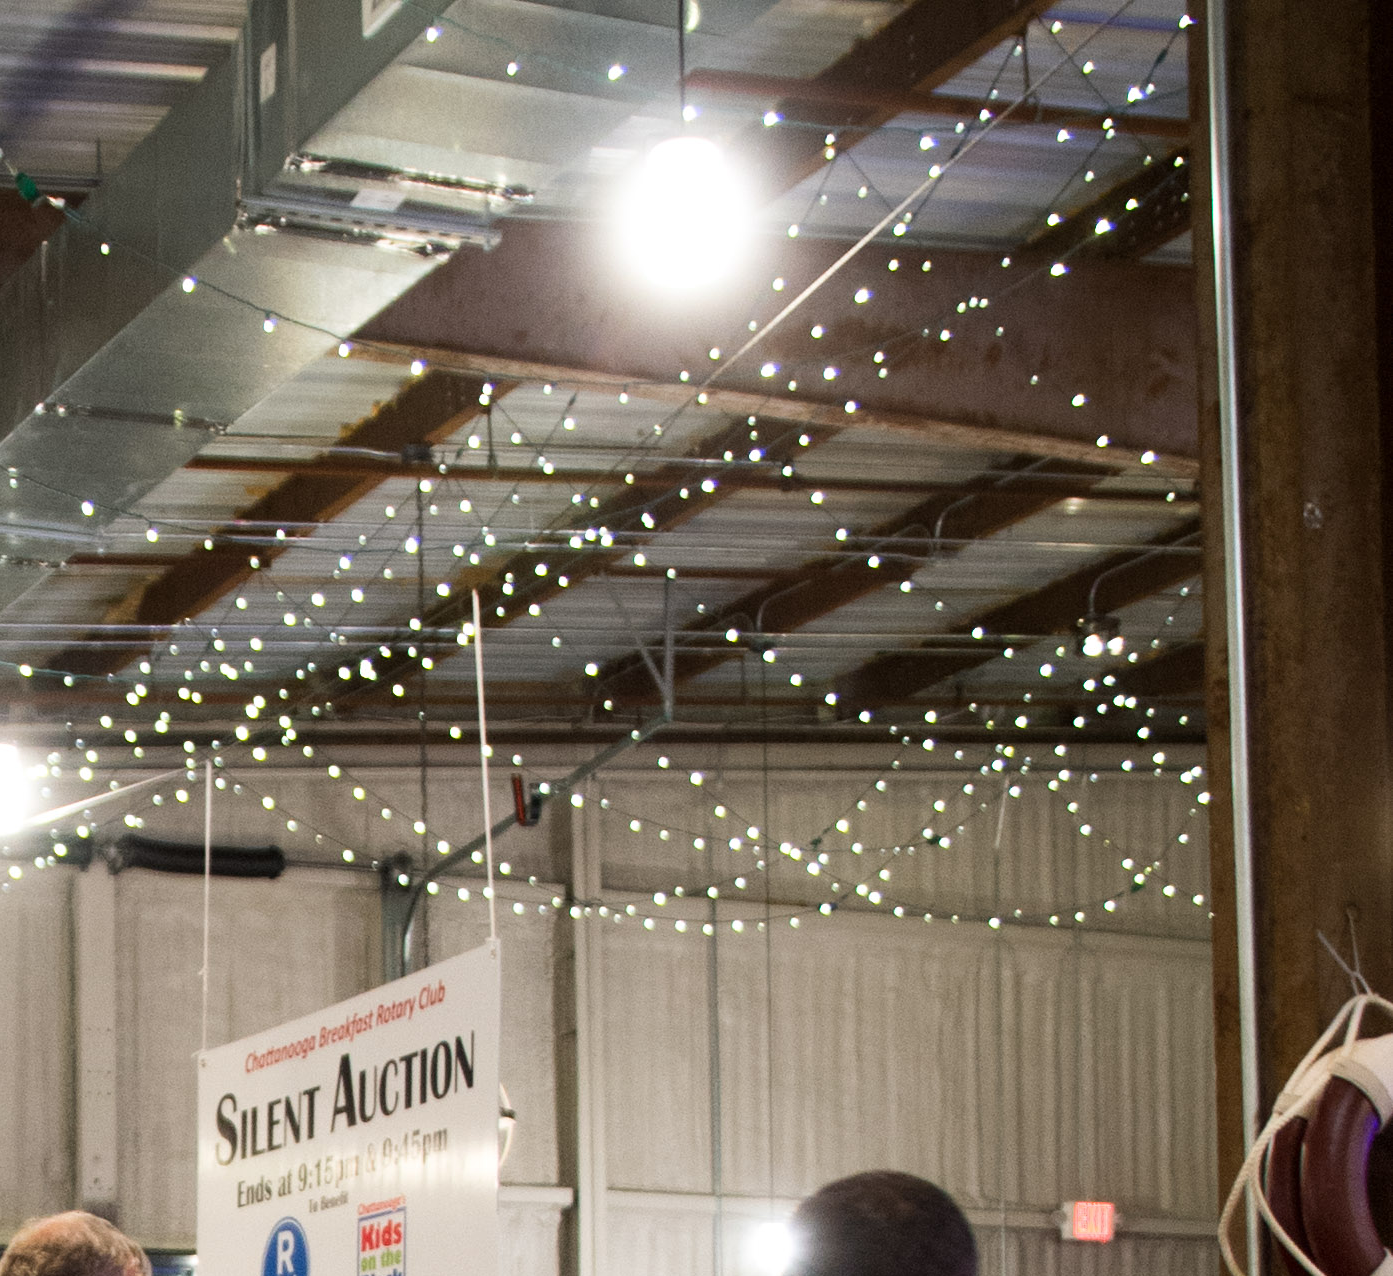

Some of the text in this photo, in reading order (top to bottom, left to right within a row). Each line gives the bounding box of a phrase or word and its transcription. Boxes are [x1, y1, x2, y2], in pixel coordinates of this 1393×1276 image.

[245, 979, 446, 1074] Chattanooga Breakfast Rotary Club
[215, 1029, 475, 1167] SILENT AUCTION
[237, 1173, 273, 1208] Ends
[278, 1170, 292, 1198] at
[276, 1230, 295, 1275] R
[361, 1219, 402, 1252] Kids
[361, 1248, 402, 1272] on the
